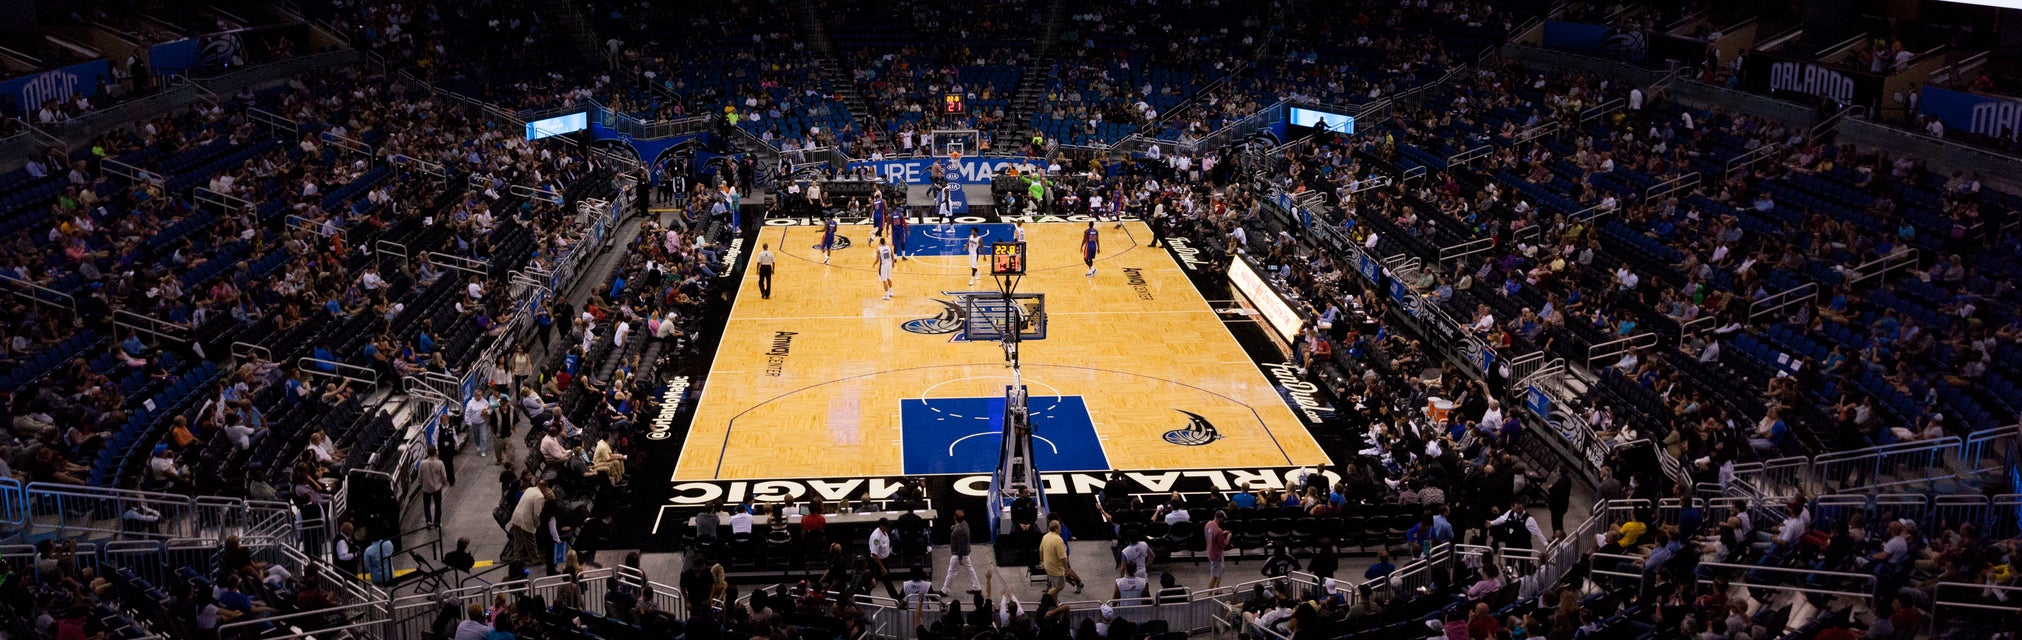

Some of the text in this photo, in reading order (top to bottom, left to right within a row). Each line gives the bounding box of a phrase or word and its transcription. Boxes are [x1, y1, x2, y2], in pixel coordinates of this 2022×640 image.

[22, 70, 79, 112] MAGIC
[1769, 61, 1854, 106] ORLANDO
[765, 331, 799, 377] Amway CENTER
[646, 375, 690, 440] @OrlandoMagic
[1261, 361, 1336, 424] FanDuel.com
